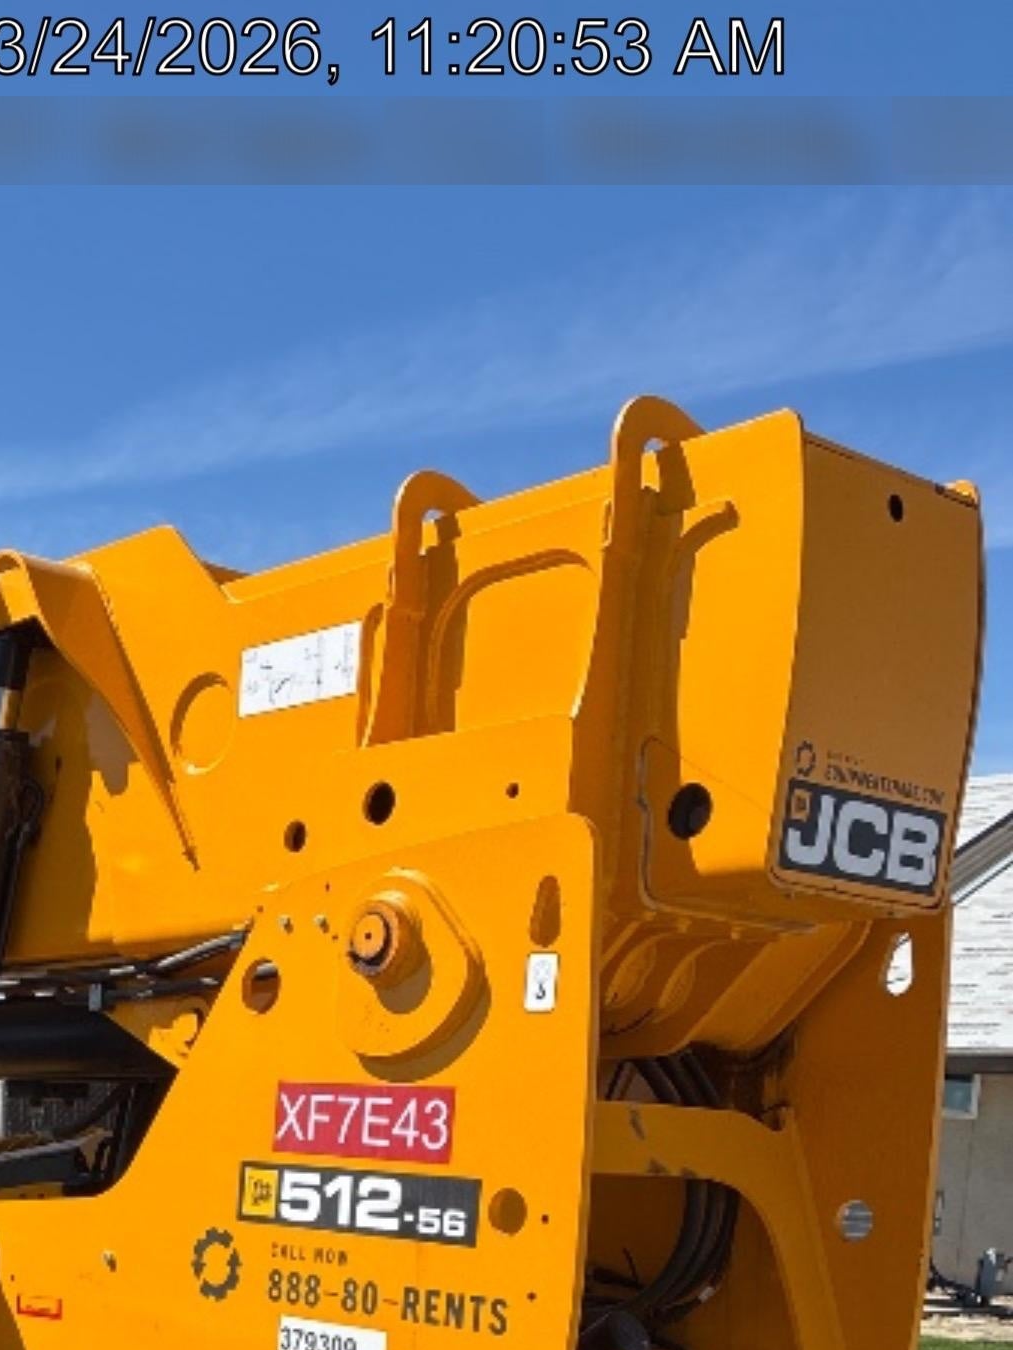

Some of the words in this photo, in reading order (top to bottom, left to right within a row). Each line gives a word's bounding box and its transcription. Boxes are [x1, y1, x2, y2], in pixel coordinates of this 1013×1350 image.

[784, 794, 940, 887] JCB
[276, 1093, 450, 1151] XF7E43
[267, 1268, 509, 1337] 888-80-RENTS
